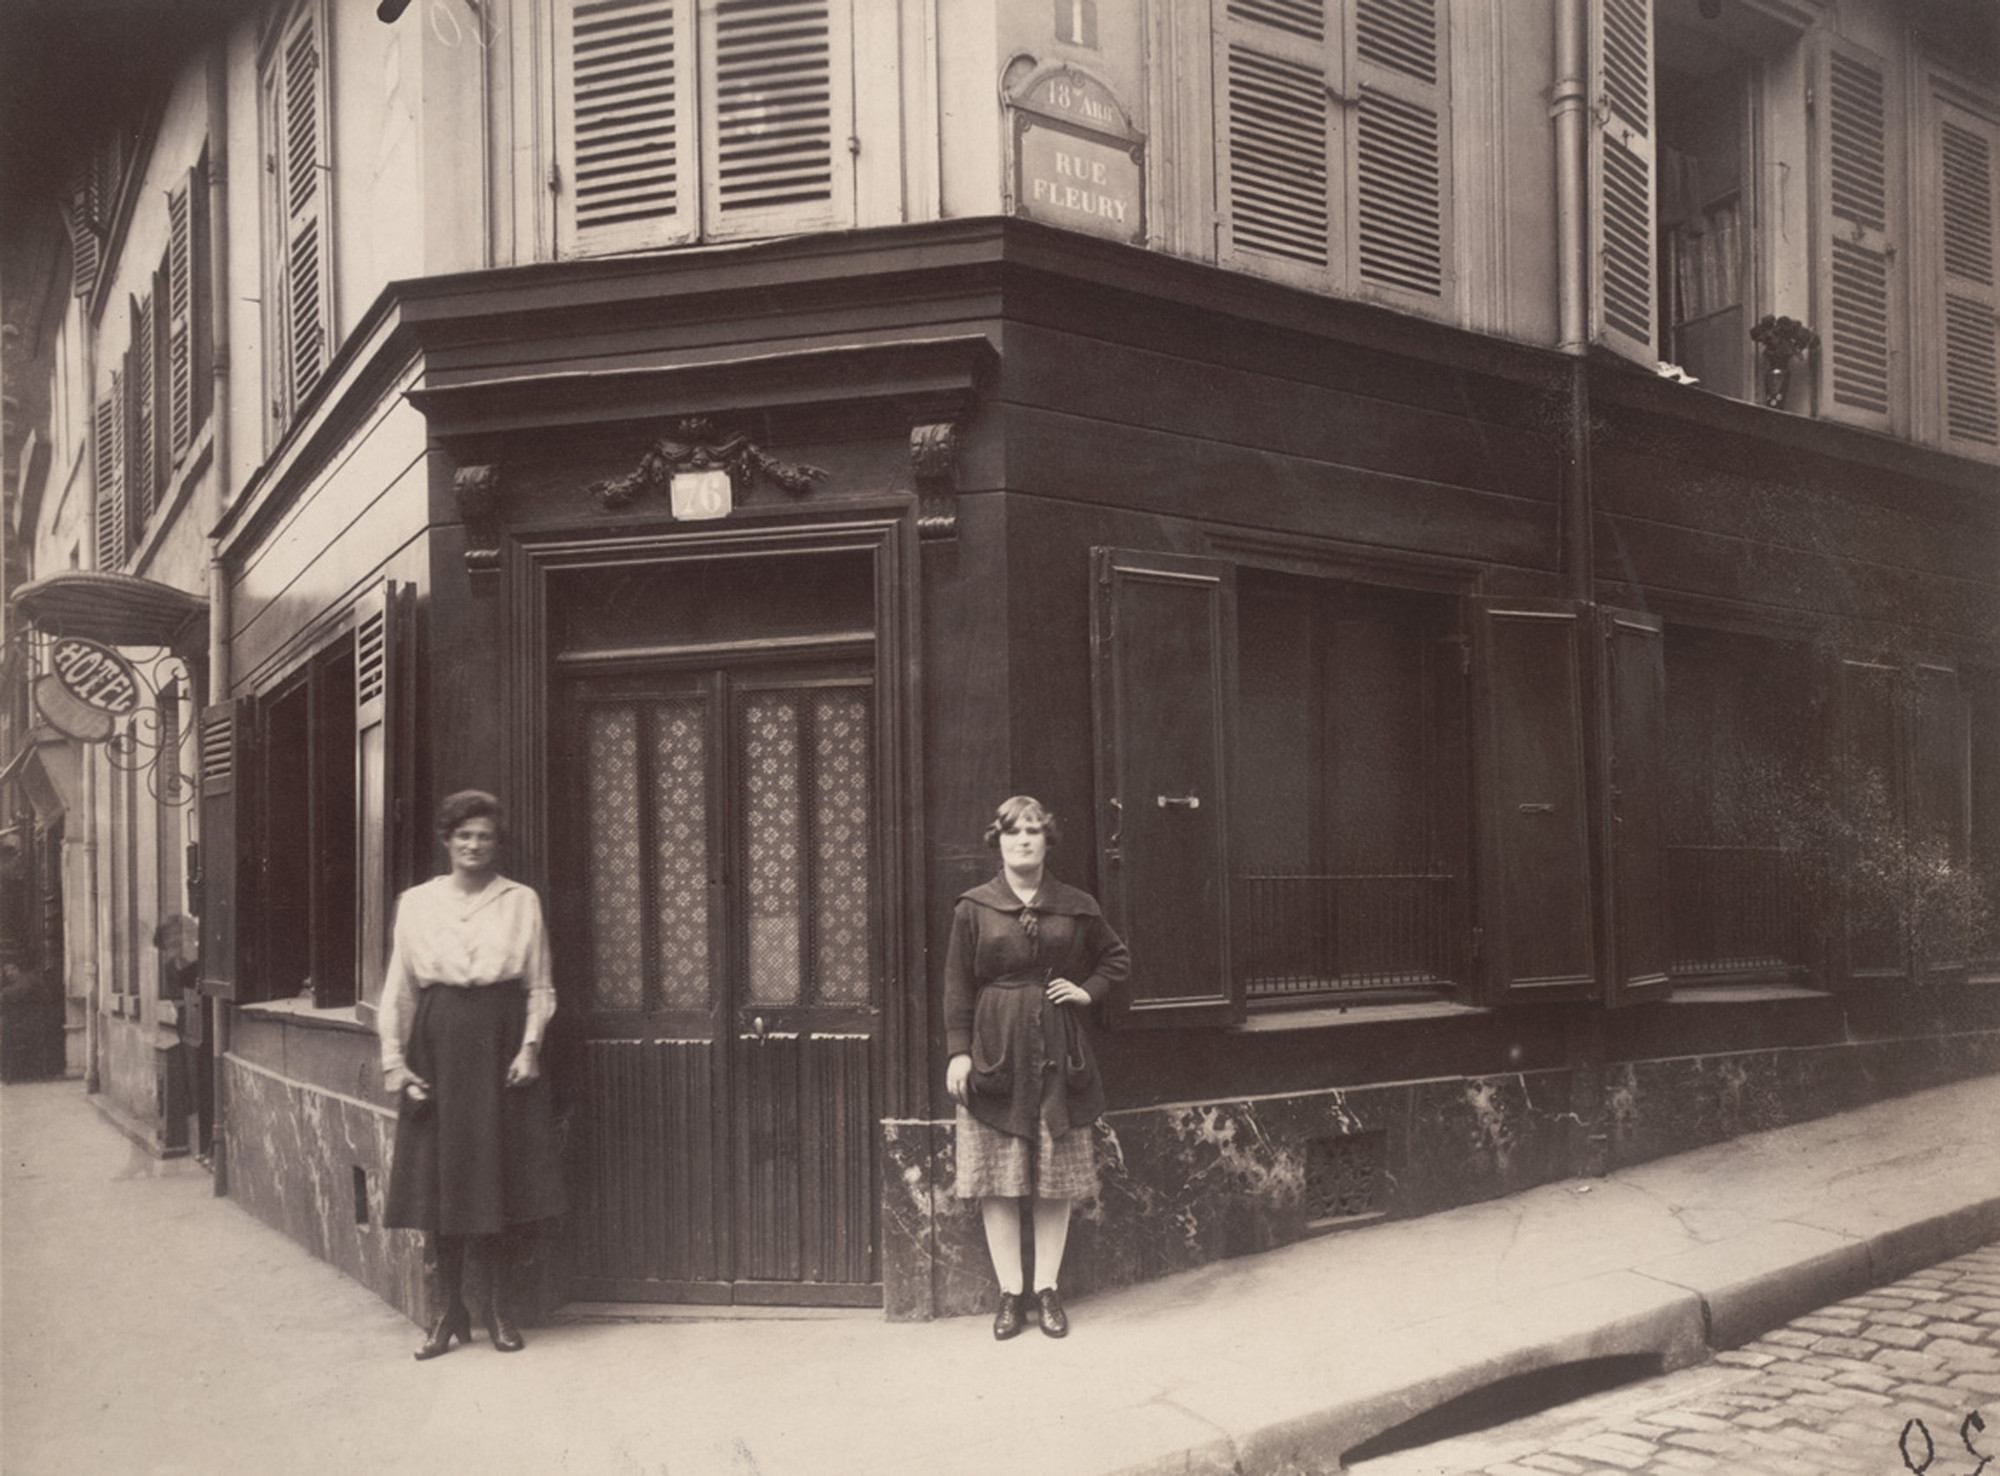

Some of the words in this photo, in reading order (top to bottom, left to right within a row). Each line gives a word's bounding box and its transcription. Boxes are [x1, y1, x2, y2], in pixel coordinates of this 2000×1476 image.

[1055, 152, 1107, 185] RUE
[1033, 178, 1128, 223] FLEURY
[675, 479, 722, 513] 76
[55, 643, 134, 711] HOTEL
